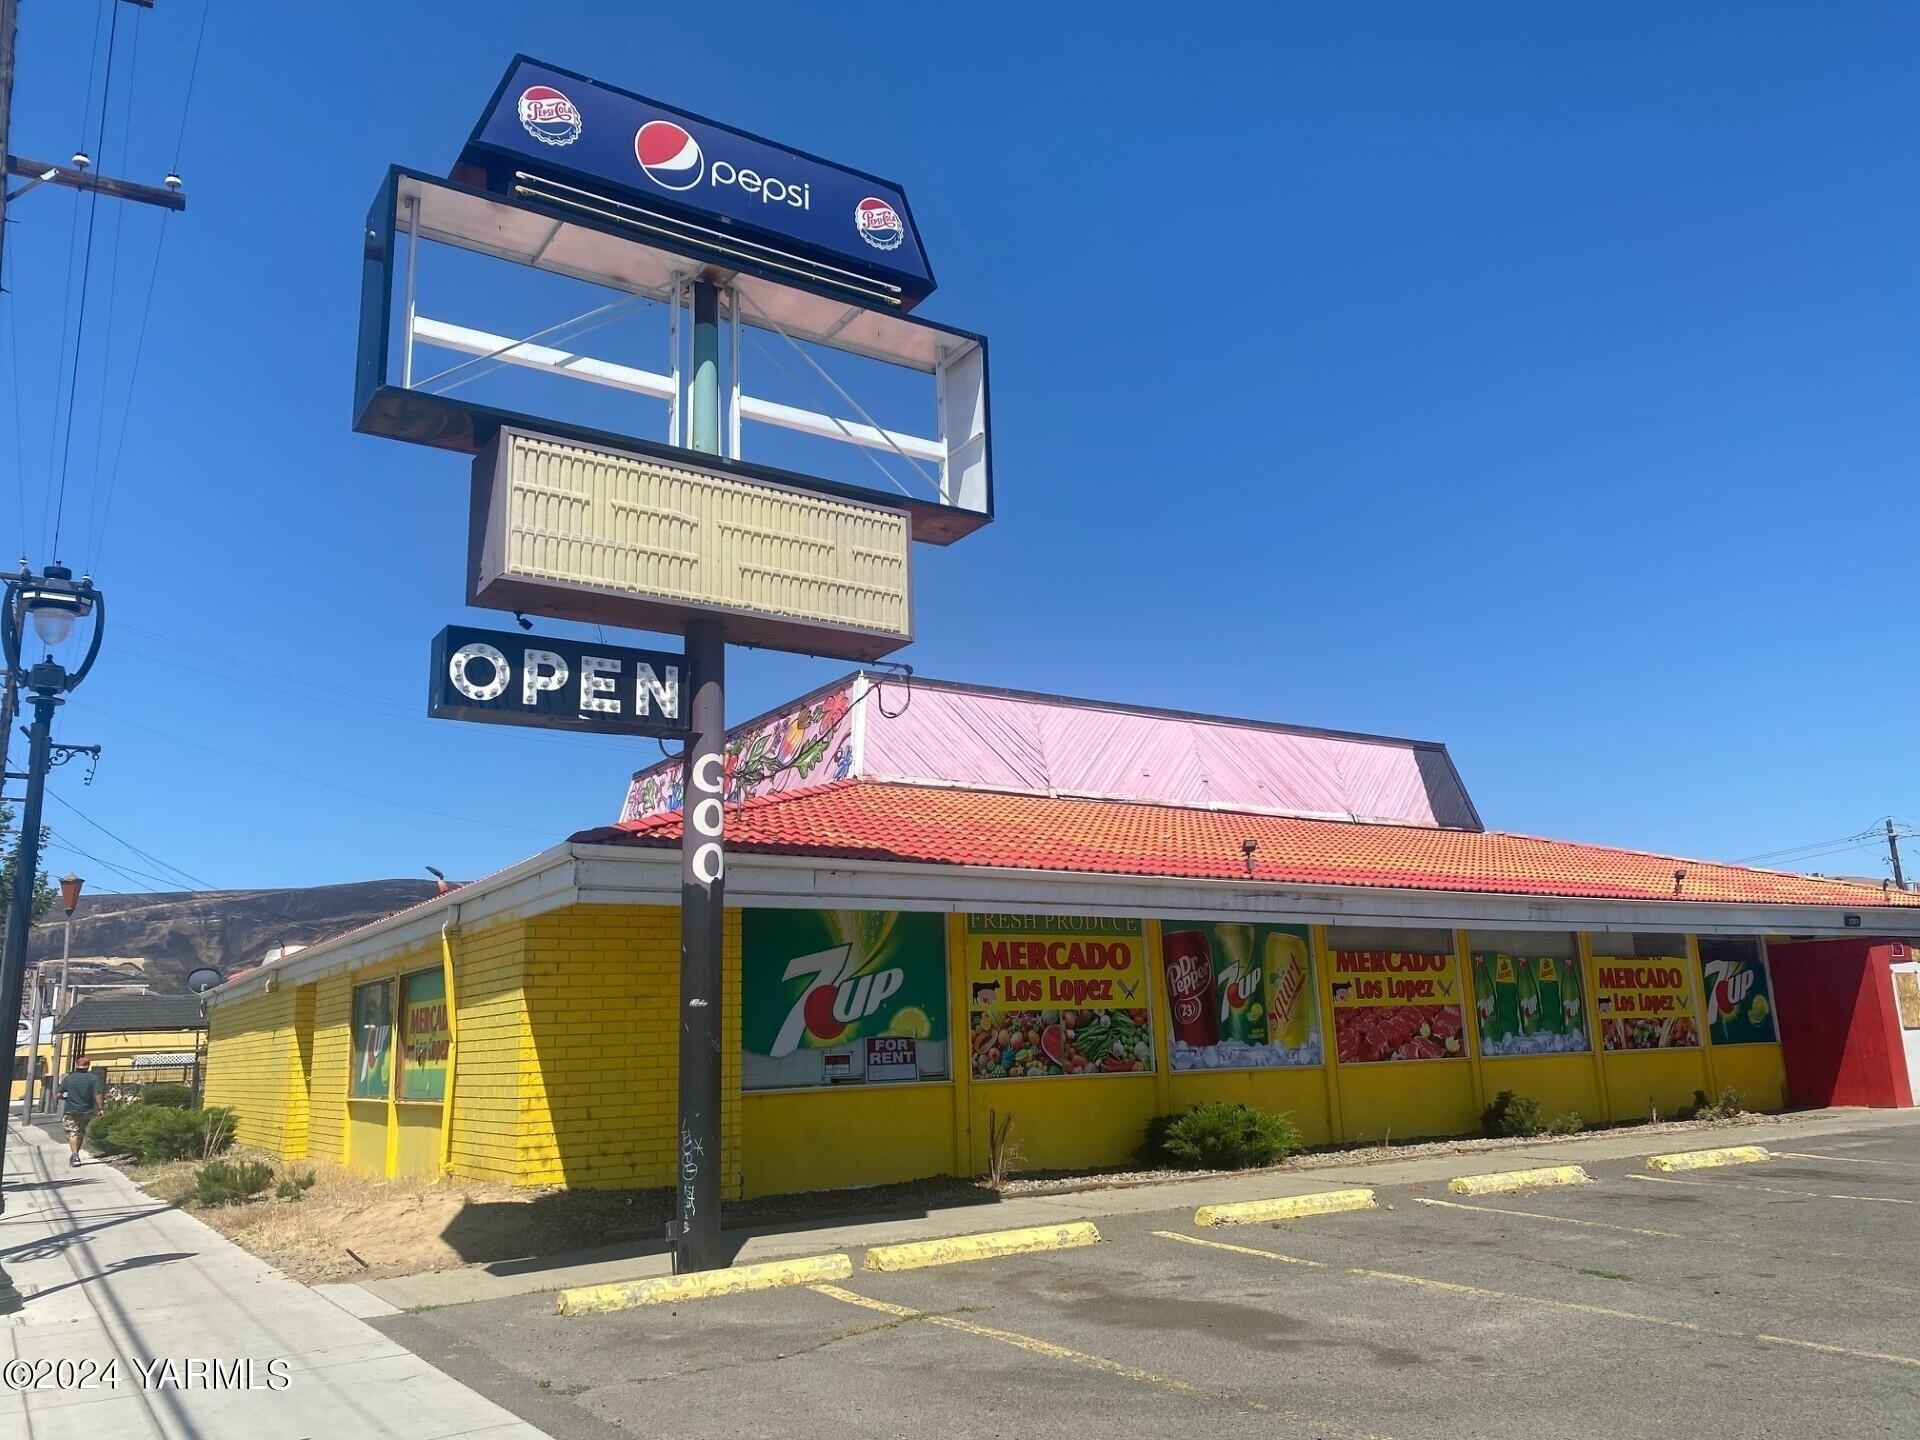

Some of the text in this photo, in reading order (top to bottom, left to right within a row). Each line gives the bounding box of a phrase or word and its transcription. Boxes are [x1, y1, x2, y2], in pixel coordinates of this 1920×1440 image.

[711, 159, 810, 210] pepsi
[449, 642, 679, 719] OPEN
[971, 913, 1137, 931] FRESH PRODUCE
[980, 941, 1131, 970] MERCADO
[1178, 955, 1198, 978] Dr
[1336, 951, 1446, 972] MERCADO
[1168, 962, 1209, 997] Pepper
[1354, 977, 1435, 1002] Los Lopez
[1599, 967, 1682, 989] MERCADO
[1005, 976, 1113, 1006] Los Lopez
[1181, 1003, 1192, 1016] 23
[1614, 993, 1675, 1014] Los Lopez
[410, 1005, 448, 1034] MERCAD
[875, 1039, 907, 1051] FOR
[869, 1051, 914, 1064] RENT
